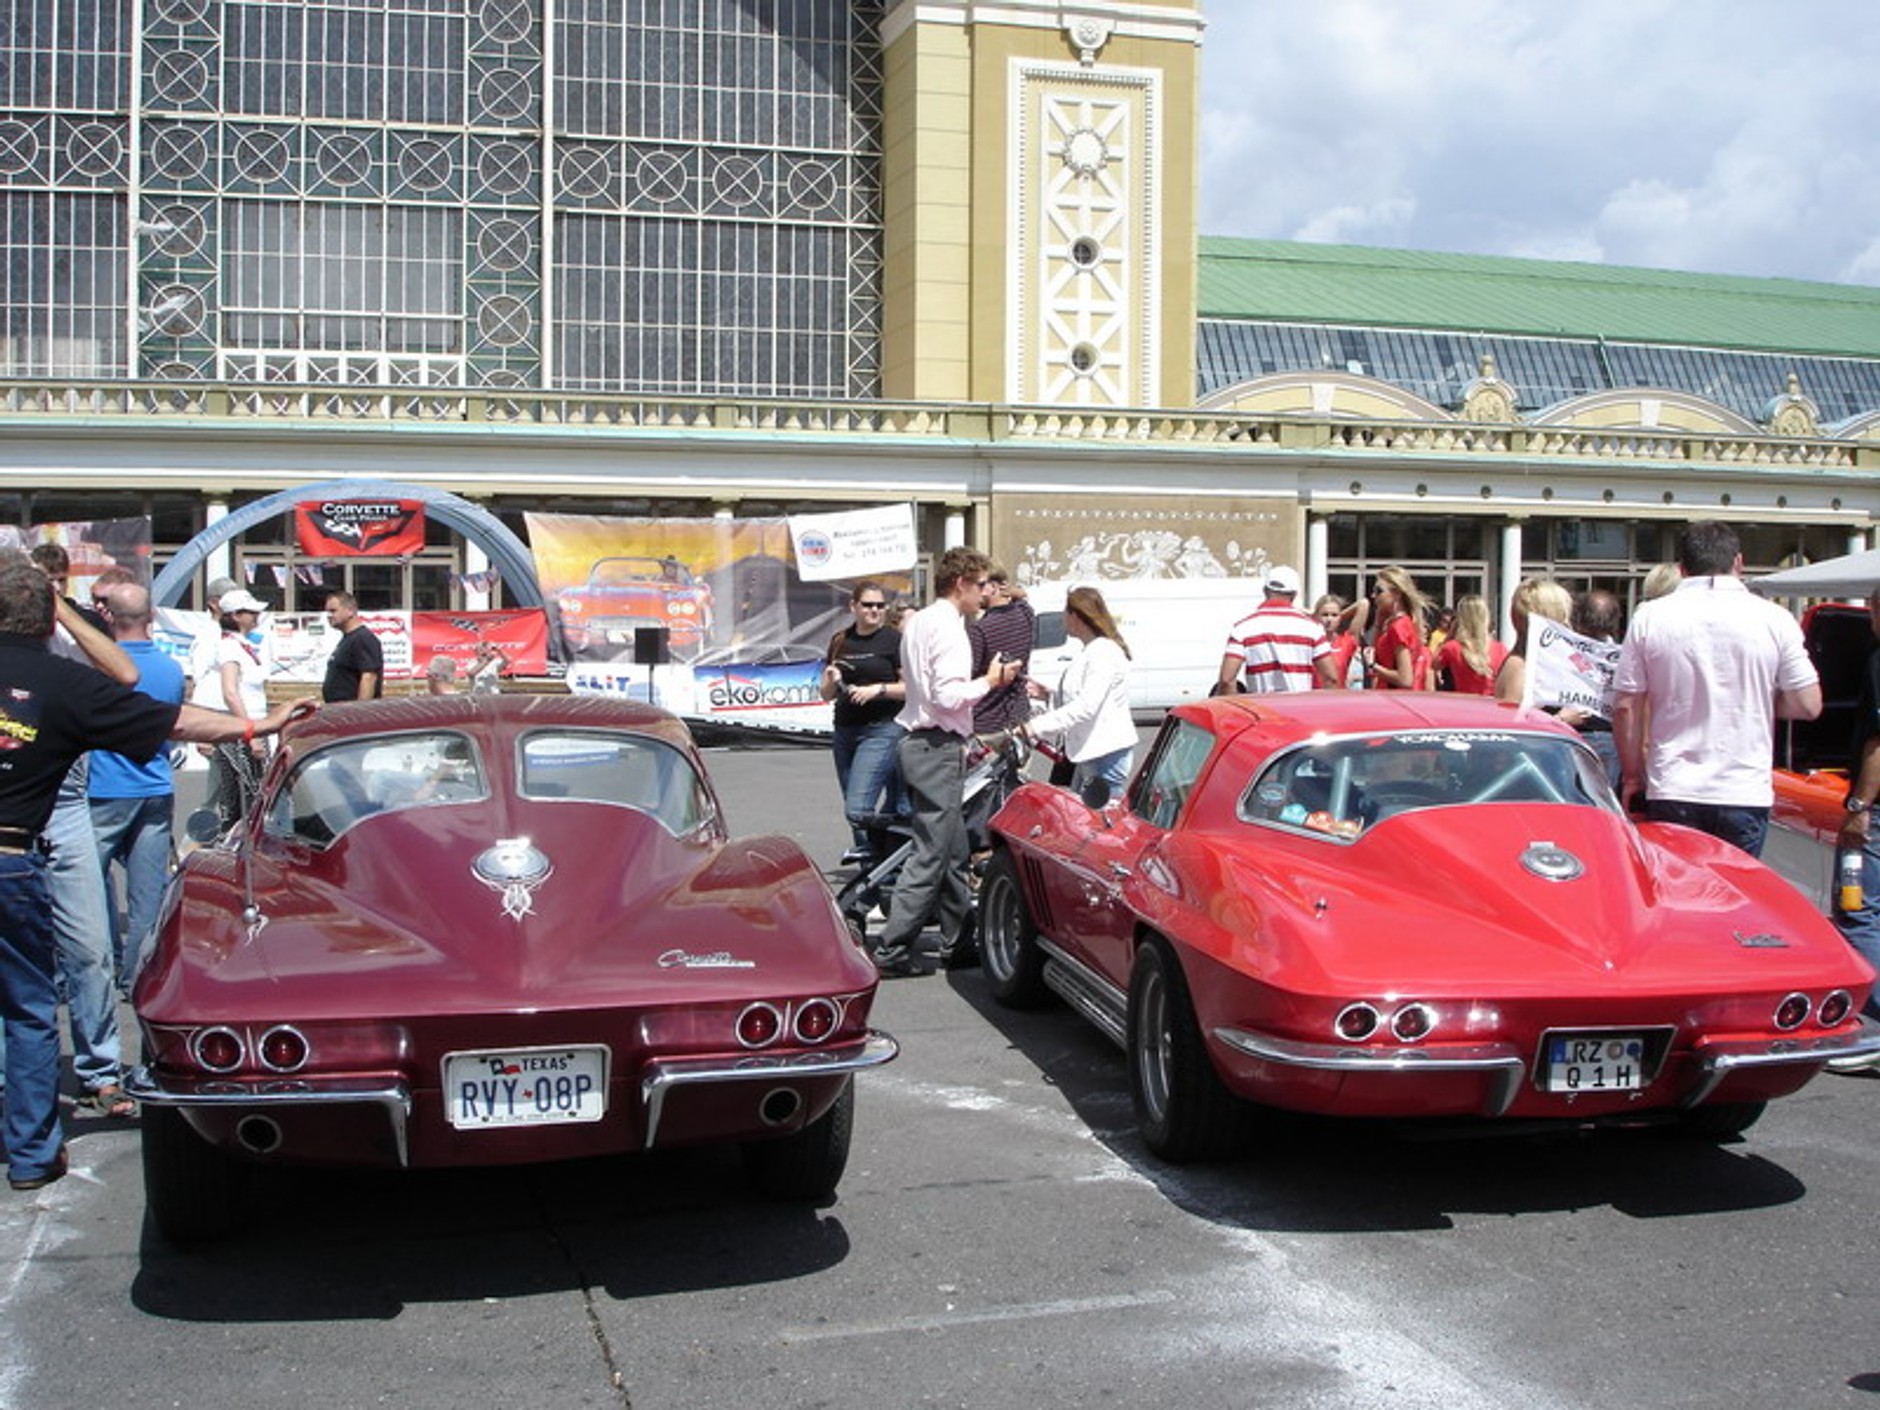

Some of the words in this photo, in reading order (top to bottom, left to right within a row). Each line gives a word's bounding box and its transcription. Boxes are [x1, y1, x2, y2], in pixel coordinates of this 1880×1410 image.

[321, 502, 401, 515] CORVETTE
[1573, 1041, 1602, 1063] RZ
[522, 1057, 568, 1071] TEXAS
[1566, 1066, 1580, 1088] Q
[1592, 1066, 1606, 1087] 1
[1616, 1064, 1631, 1087] H
[461, 1078, 518, 1119] RVY
